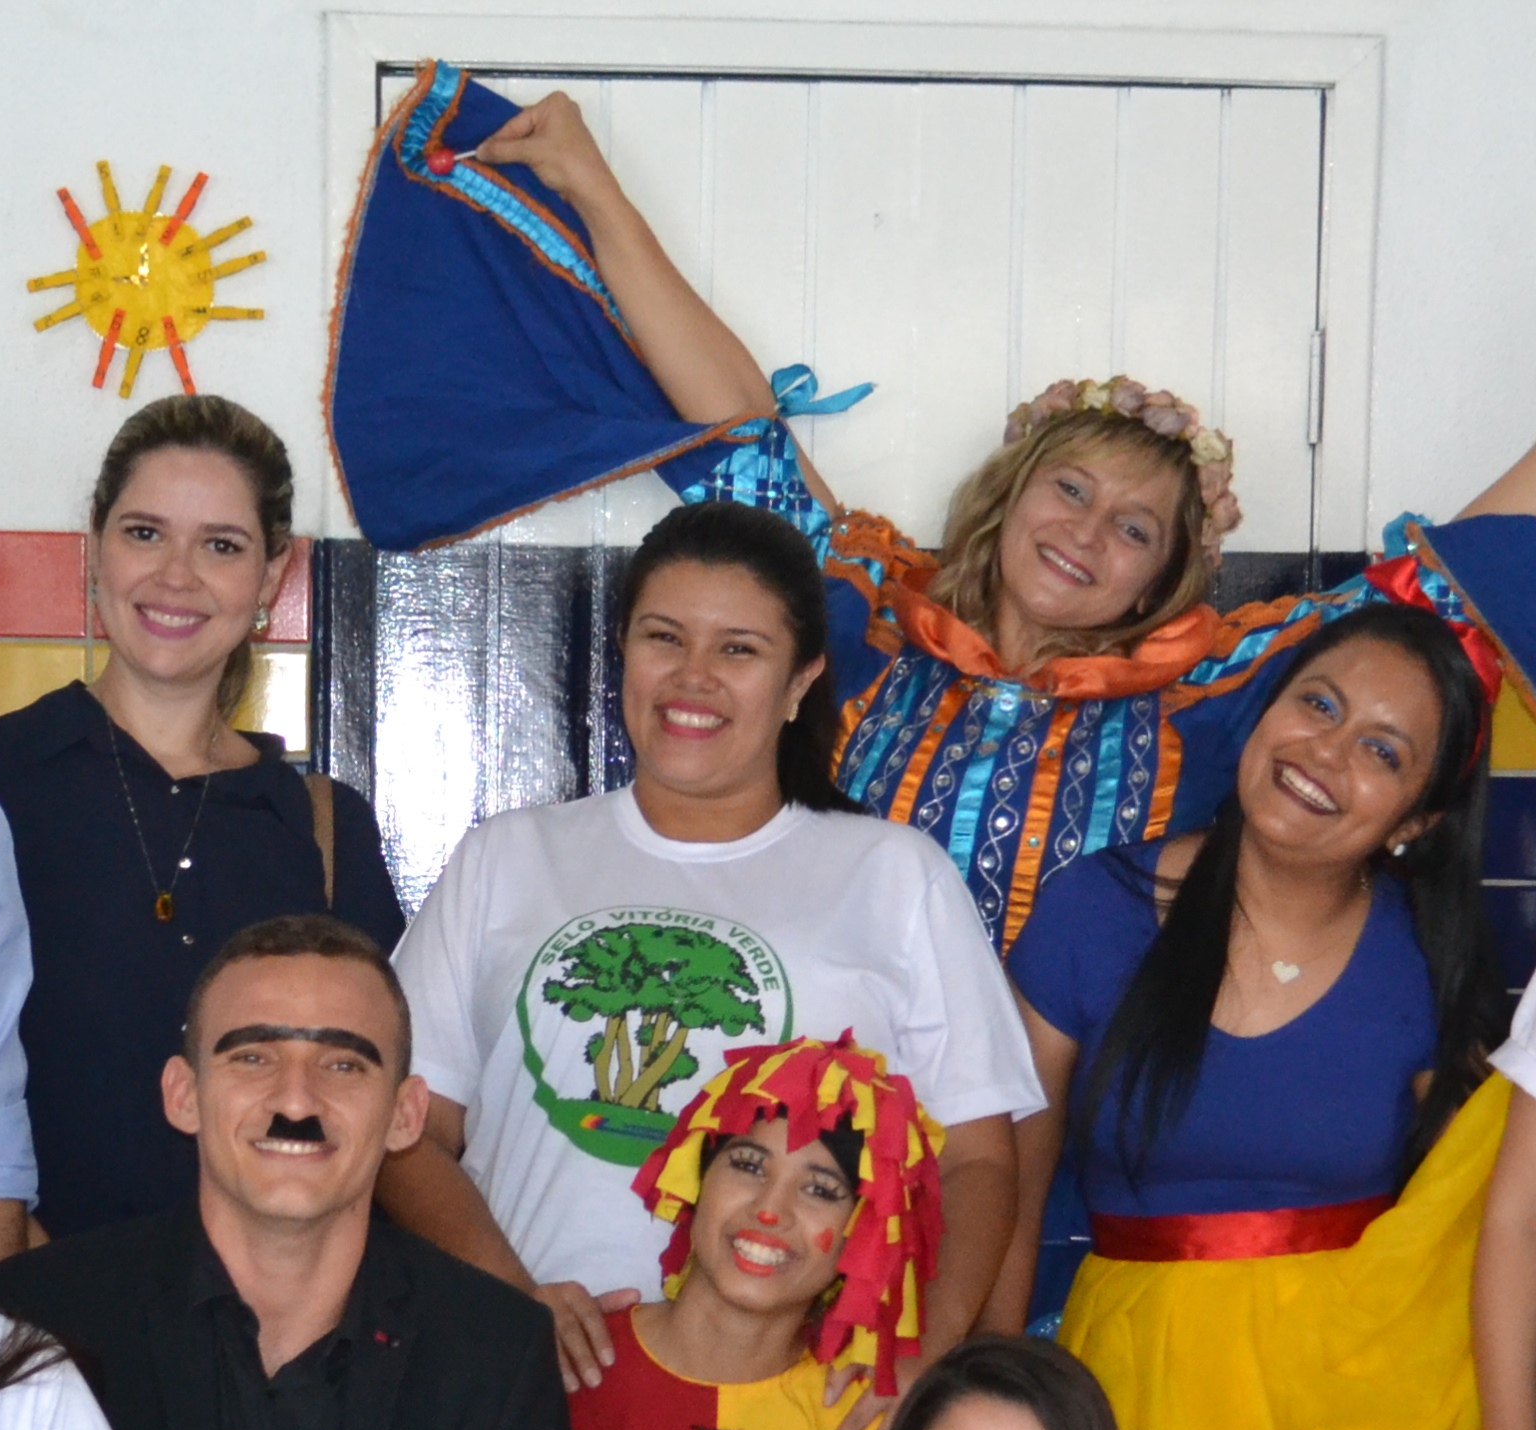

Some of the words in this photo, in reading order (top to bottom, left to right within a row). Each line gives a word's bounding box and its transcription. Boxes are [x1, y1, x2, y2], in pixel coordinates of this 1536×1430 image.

[136, 326, 150, 346] 8
[540, 919, 595, 967] SELO
[609, 907, 716, 931] VITÓRIA
[728, 926, 781, 992] VERDE
